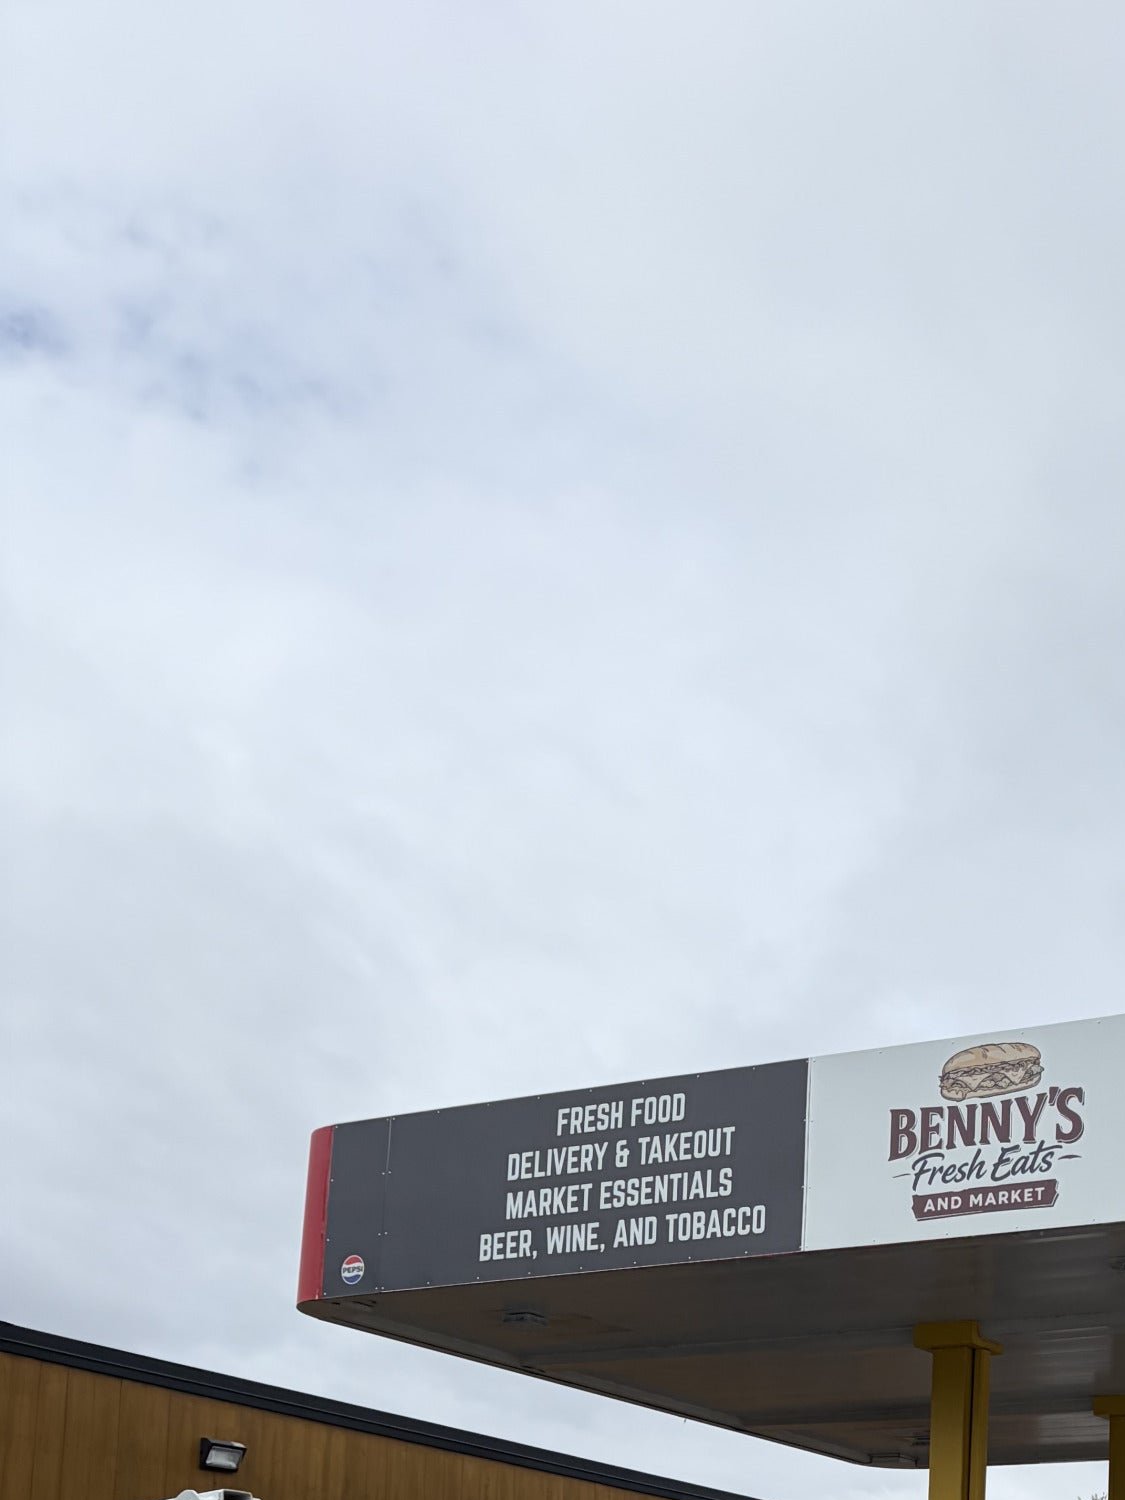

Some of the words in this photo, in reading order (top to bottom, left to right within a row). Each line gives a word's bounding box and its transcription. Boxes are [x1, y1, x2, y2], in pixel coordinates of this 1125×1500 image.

[556, 1100, 623, 1136] FRESH
[629, 1092, 686, 1127] FOOD
[888, 1086, 1085, 1162] BENNY'S
[507, 1141, 608, 1181] DELIVERY
[615, 1139, 630, 1168] &
[638, 1126, 736, 1166] TAKEOUT
[911, 1148, 987, 1191] Fresh
[990, 1140, 1063, 1182] Eats
[505, 1183, 593, 1220] MARKET
[599, 1167, 733, 1210] ESSENTIALS
[923, 1196, 962, 1213] AND
[969, 1187, 1046, 1208] MARKET
[479, 1229, 538, 1262] BEER,
[546, 1222, 605, 1255] WINE,
[612, 1216, 657, 1249] AND
[665, 1205, 766, 1243] TOBACCO
